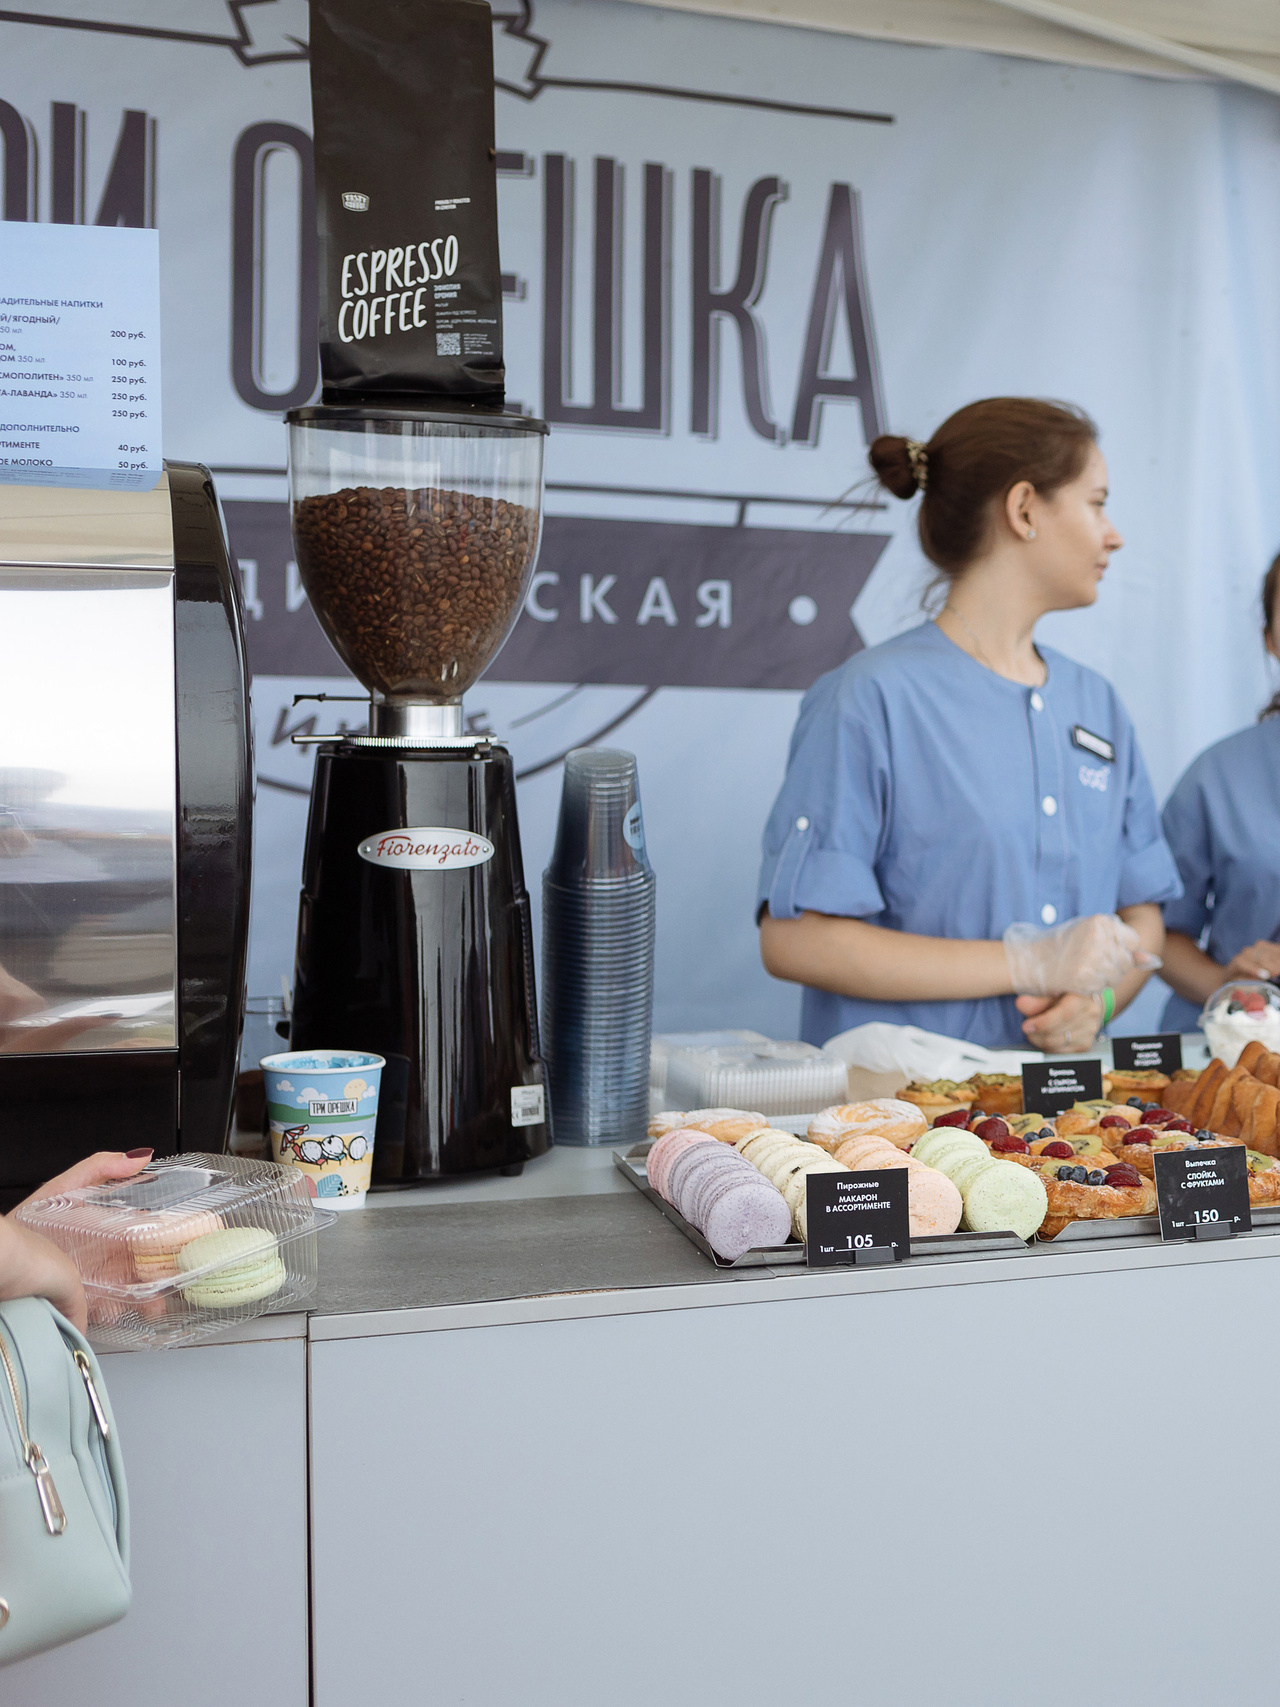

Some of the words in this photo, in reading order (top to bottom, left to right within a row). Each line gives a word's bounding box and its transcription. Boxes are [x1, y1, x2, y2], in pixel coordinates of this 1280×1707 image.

[341, 234, 459, 299] ESPRESSO
[231, 120, 889, 448] ОШКА
[61, 300, 103, 308] НАПИТКИ
[337, 287, 428, 343] COFFEE
[128, 332, 146, 340] руб.
[128, 360, 146, 368] руб.
[66, 374, 82, 382] 350
[129, 377, 147, 385] руб.
[130, 394, 147, 402] руб.
[130, 411, 148, 420] руб.
[0, 424, 80, 433] ДОПОЛНИТЕЛЬНО
[0, 441, 40, 449] ТИМЕНТЕ
[130, 445, 148, 453] руб.
[11, 458, 53, 467] МОЛОКО
[130, 462, 148, 470] руб.
[377, 835, 480, 865] Fiorenzato
[312, 1102, 326, 1114] ТРИ
[328, 1101, 354, 1114] ОРЕШКА
[1185, 1160, 1216, 1168] Выпечка
[1187, 1170, 1217, 1180] СЛОЙКА
[836, 1182, 880, 1191] Пирожные
[1186, 1178, 1224, 1188] ФРУКТАМИ
[838, 1194, 878, 1203] МАКАРОН
[826, 1205, 831, 1213] В
[832, 1201, 891, 1212] АССОРТИМЕНТЕ
[1194, 1208, 1219, 1223] 150
[846, 1234, 874, 1249] 105
